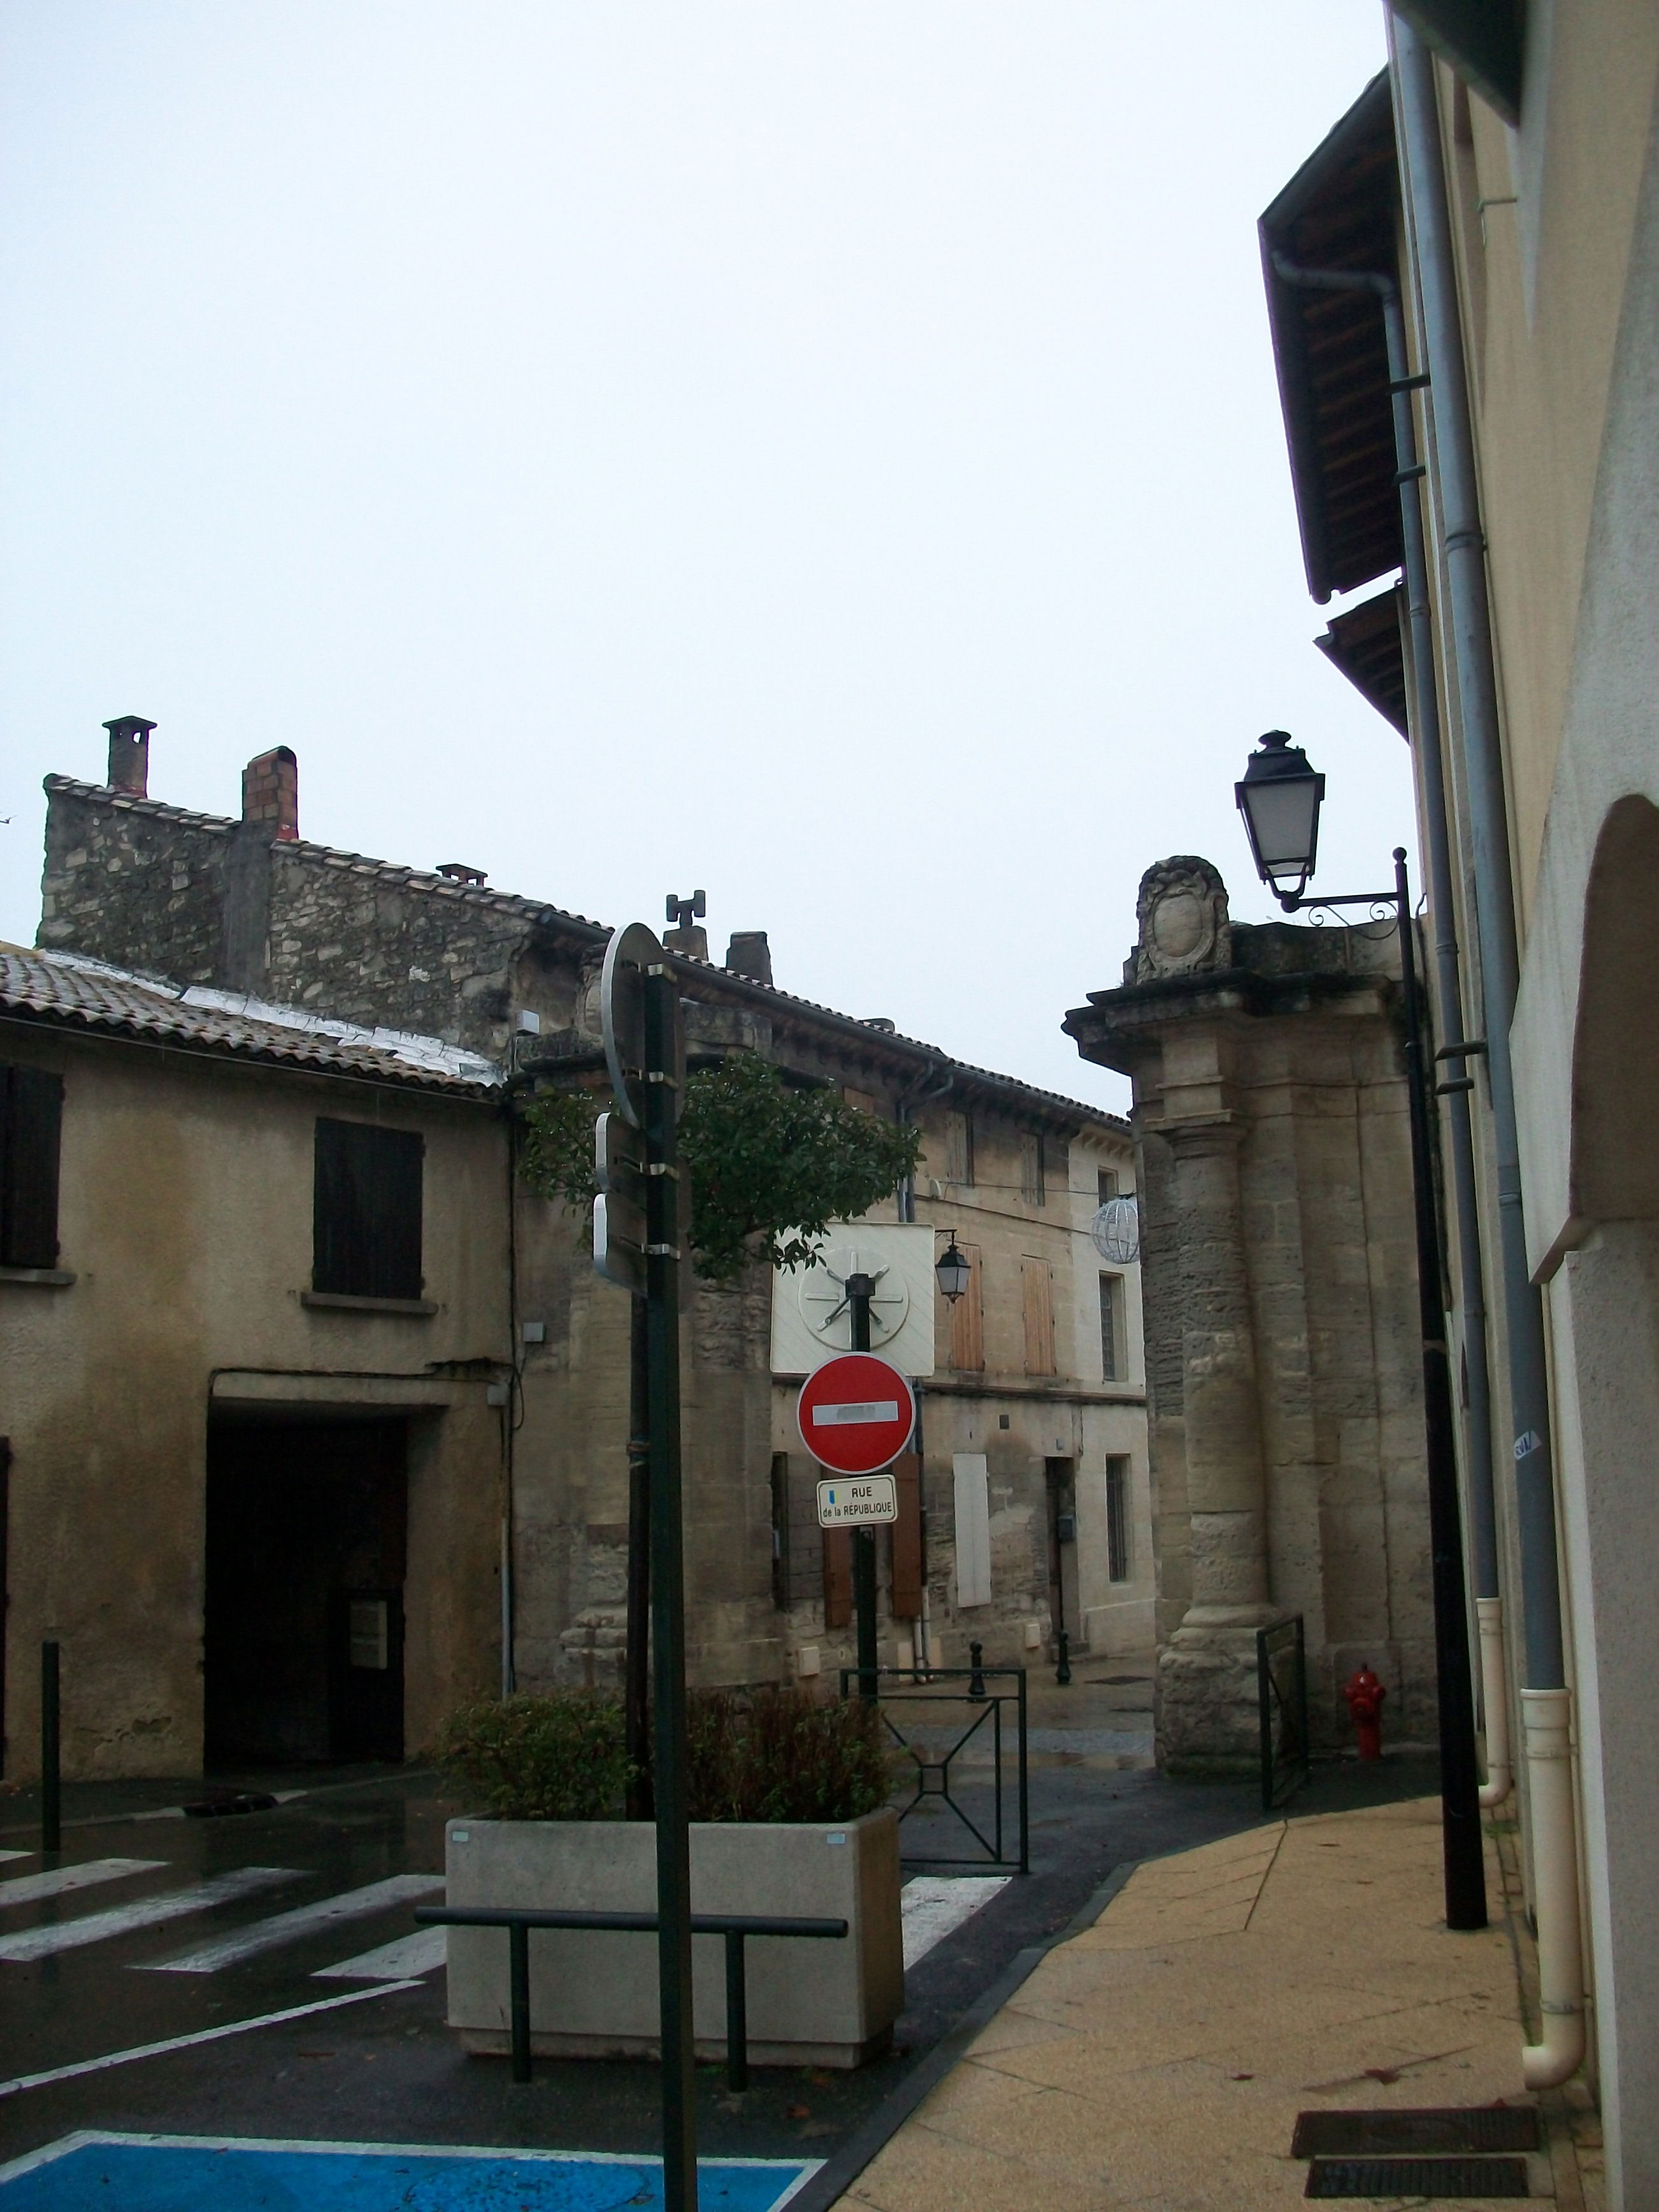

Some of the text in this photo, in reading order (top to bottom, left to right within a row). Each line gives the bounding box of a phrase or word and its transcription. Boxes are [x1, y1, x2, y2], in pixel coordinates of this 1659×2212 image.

[852, 1486, 872, 1498] RUE
[823, 1502, 892, 1518] de la RÉPUBLIQUE
